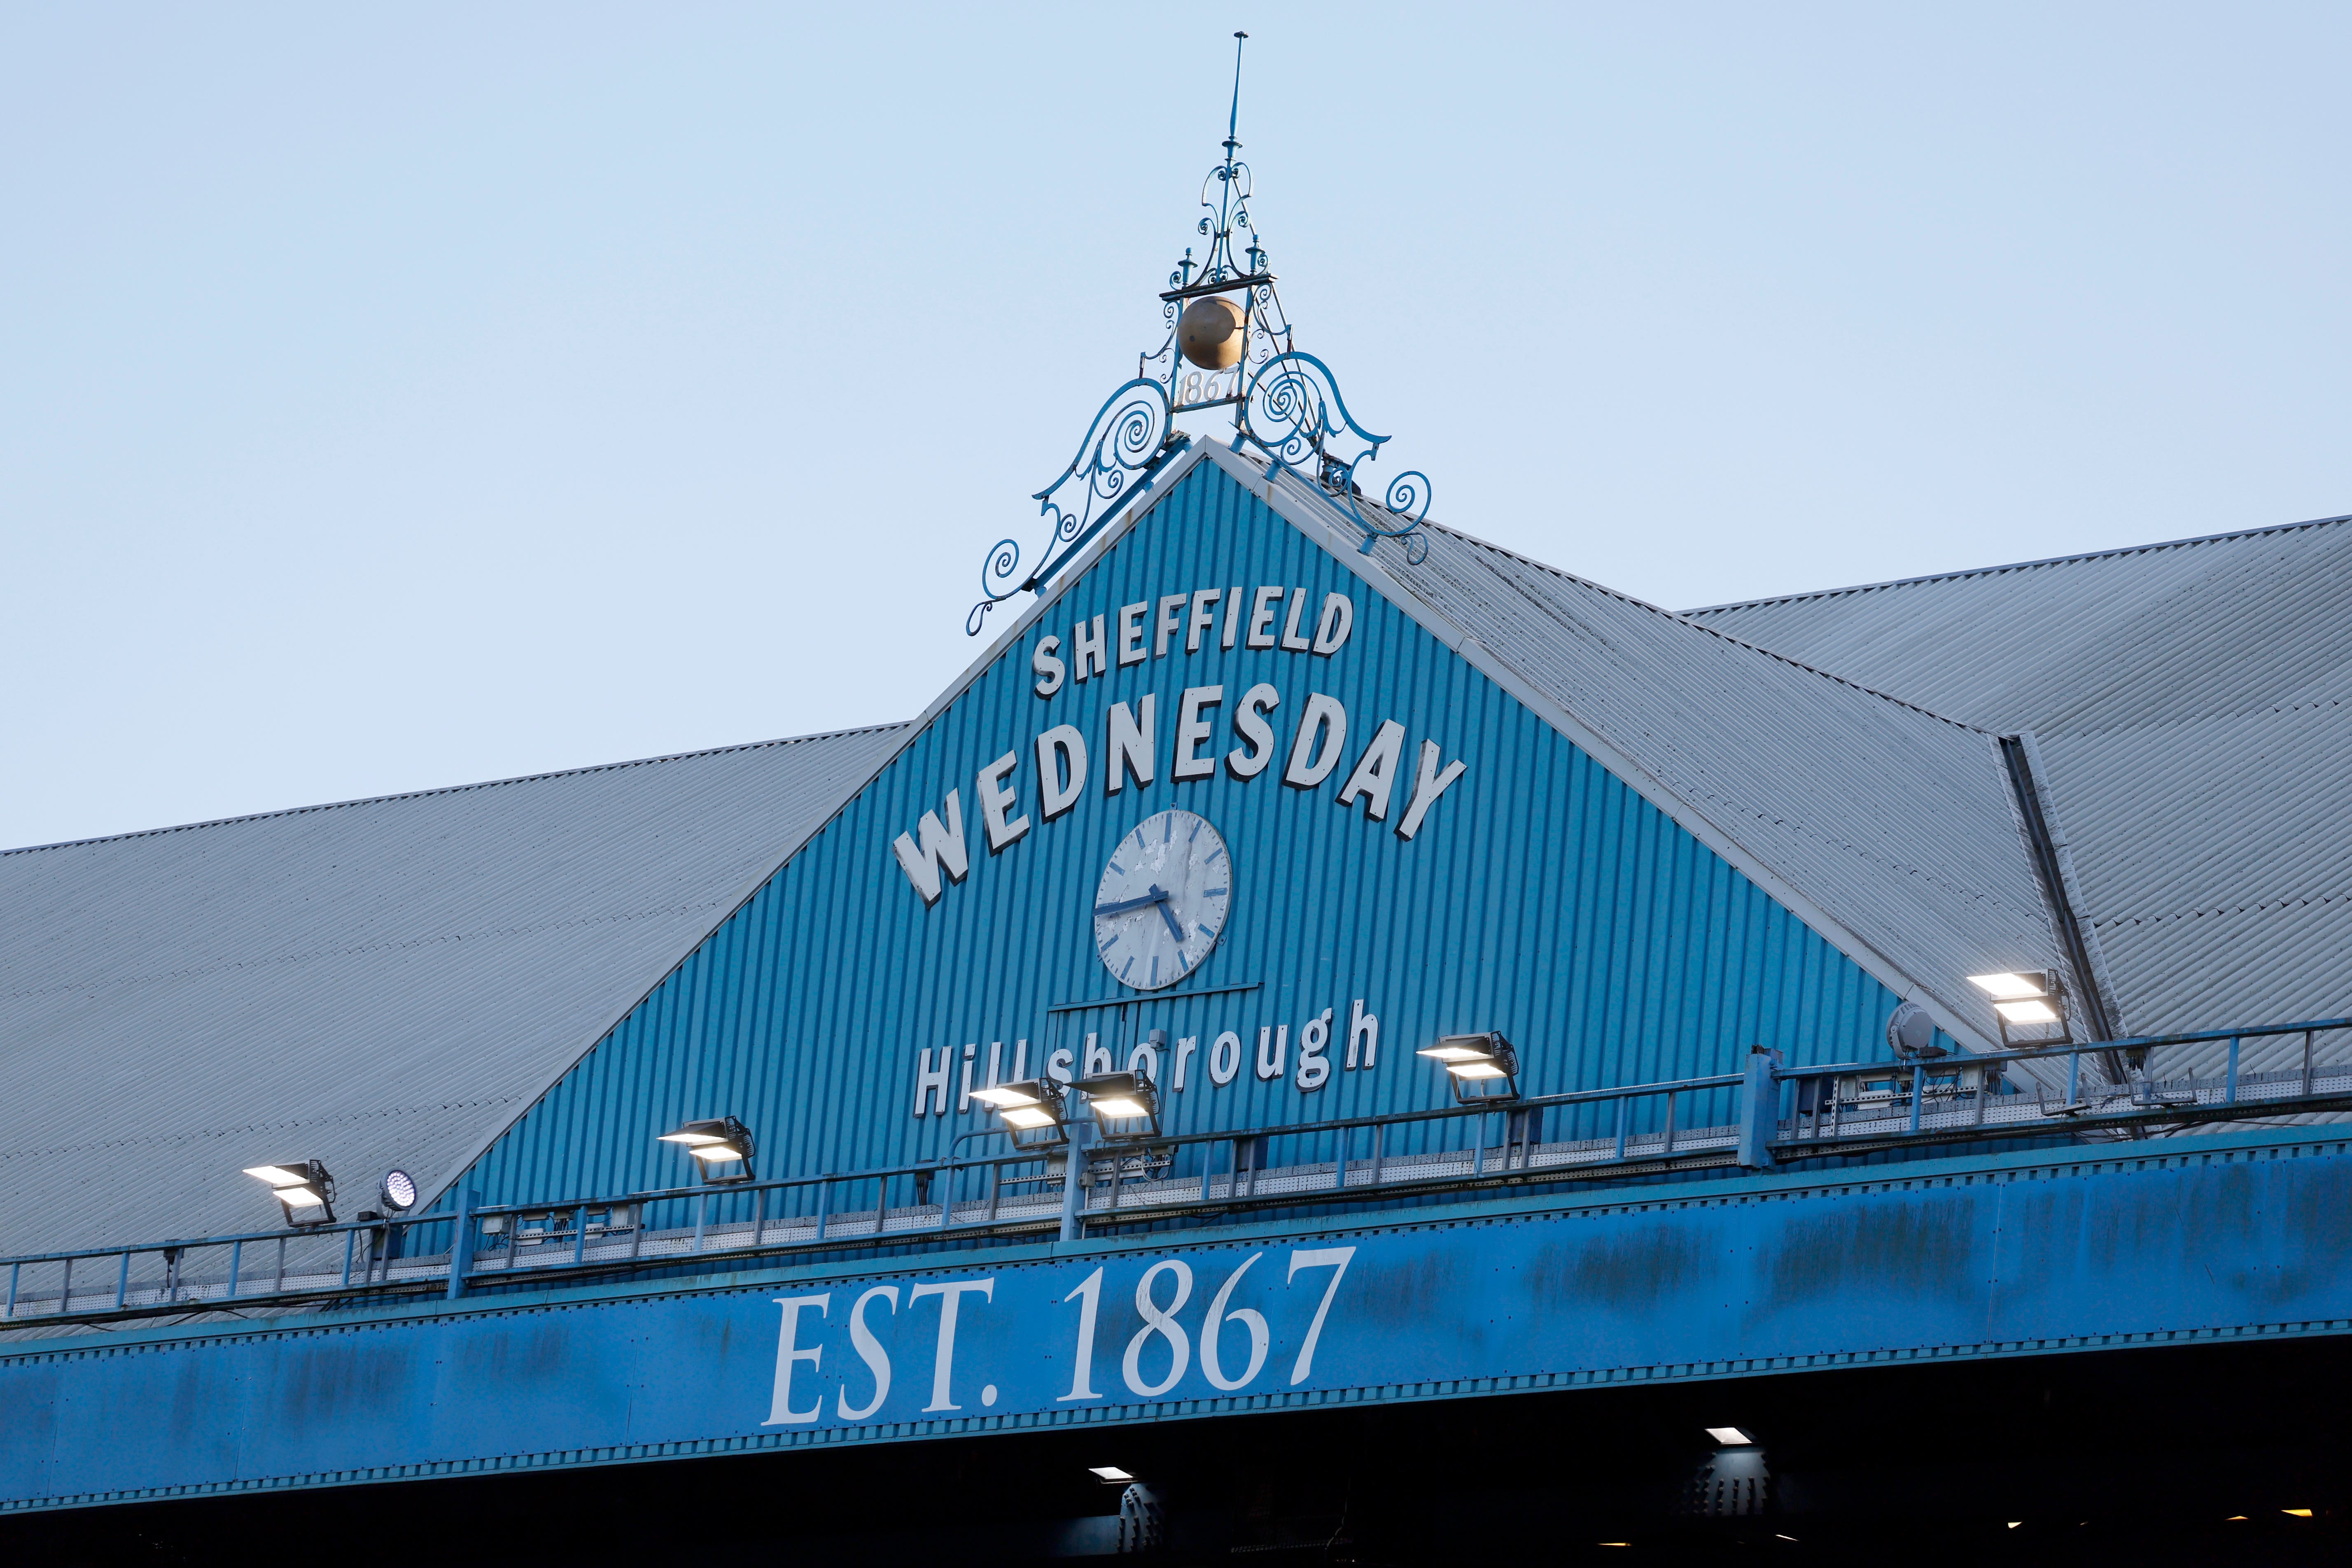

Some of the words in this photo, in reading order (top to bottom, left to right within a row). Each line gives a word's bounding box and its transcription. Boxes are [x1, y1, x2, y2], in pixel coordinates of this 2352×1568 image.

[1178, 365, 1239, 405] 1867
[1032, 586, 1353, 699] SHEFFIELD
[892, 682, 1467, 908] WEDNESDAY
[760, 1276, 997, 1426] EST.
[1056, 1246, 1356, 1402] 1867
